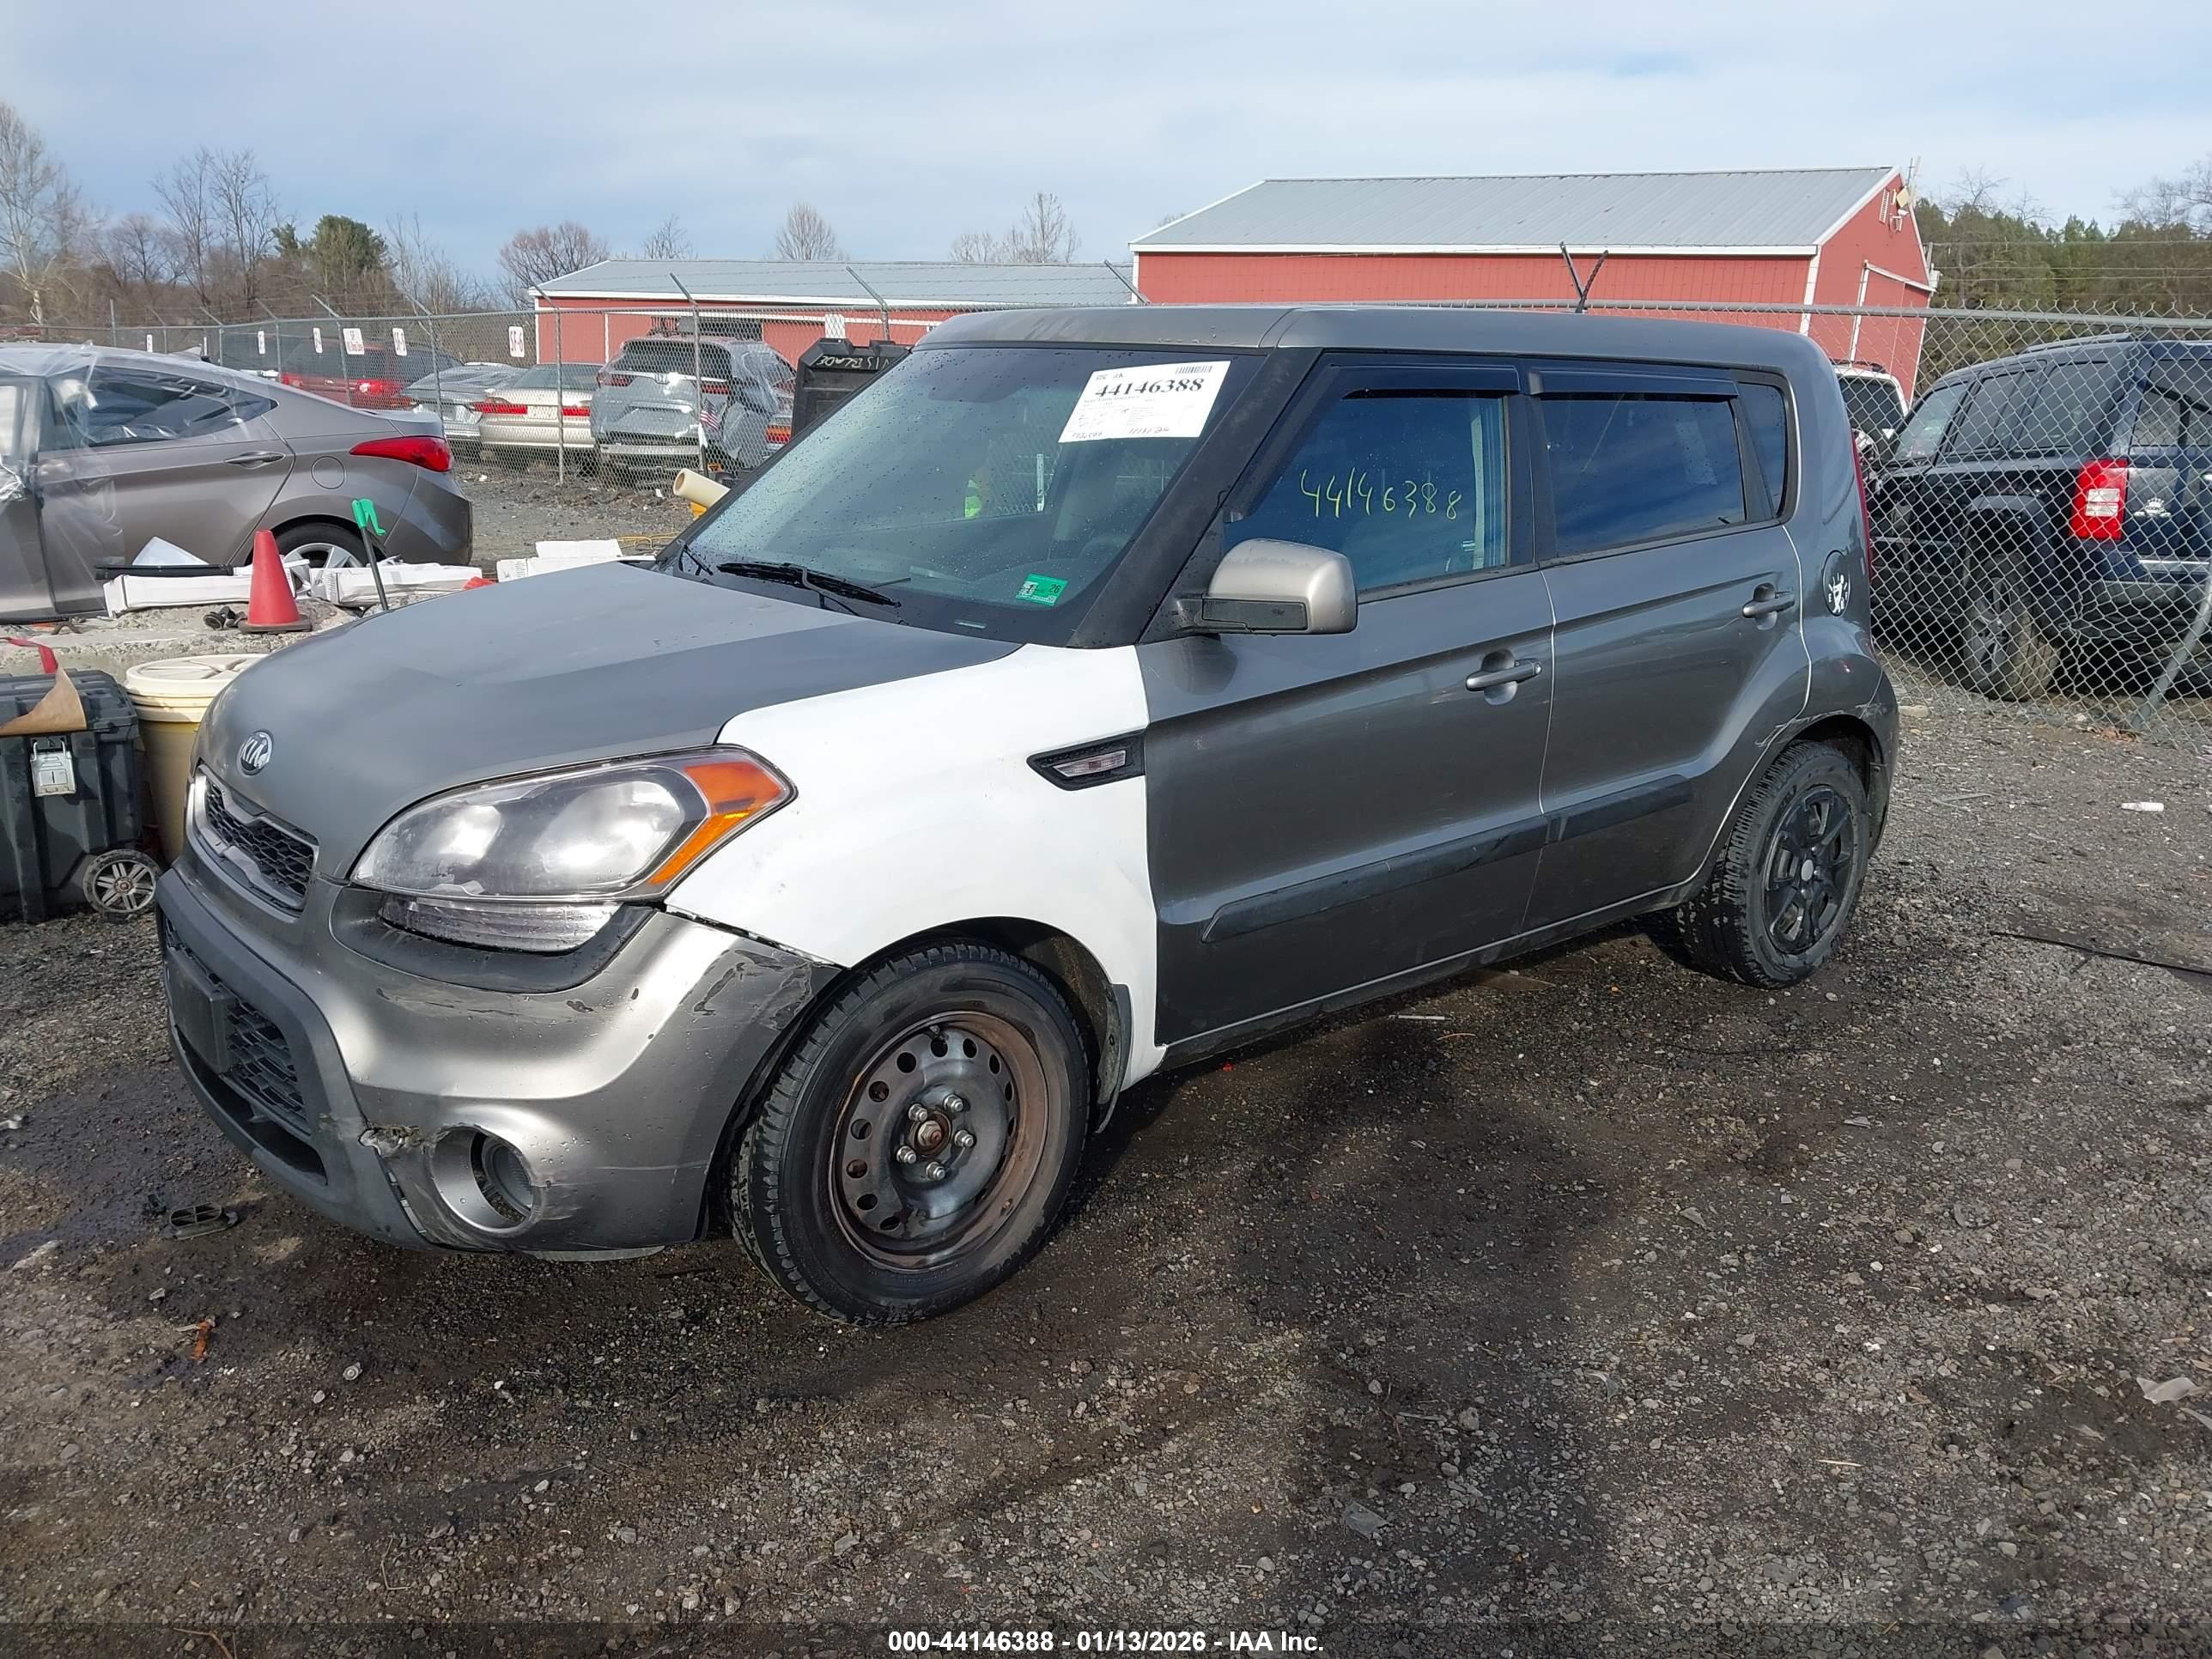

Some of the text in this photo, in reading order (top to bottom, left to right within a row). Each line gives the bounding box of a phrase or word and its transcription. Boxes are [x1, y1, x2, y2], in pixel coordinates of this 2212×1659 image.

[510, 330, 524, 352] SF-6
[1096, 378, 1204, 397] 44146388
[1300, 466, 1462, 520] 44146388
[1049, 584, 1061, 593] 26
